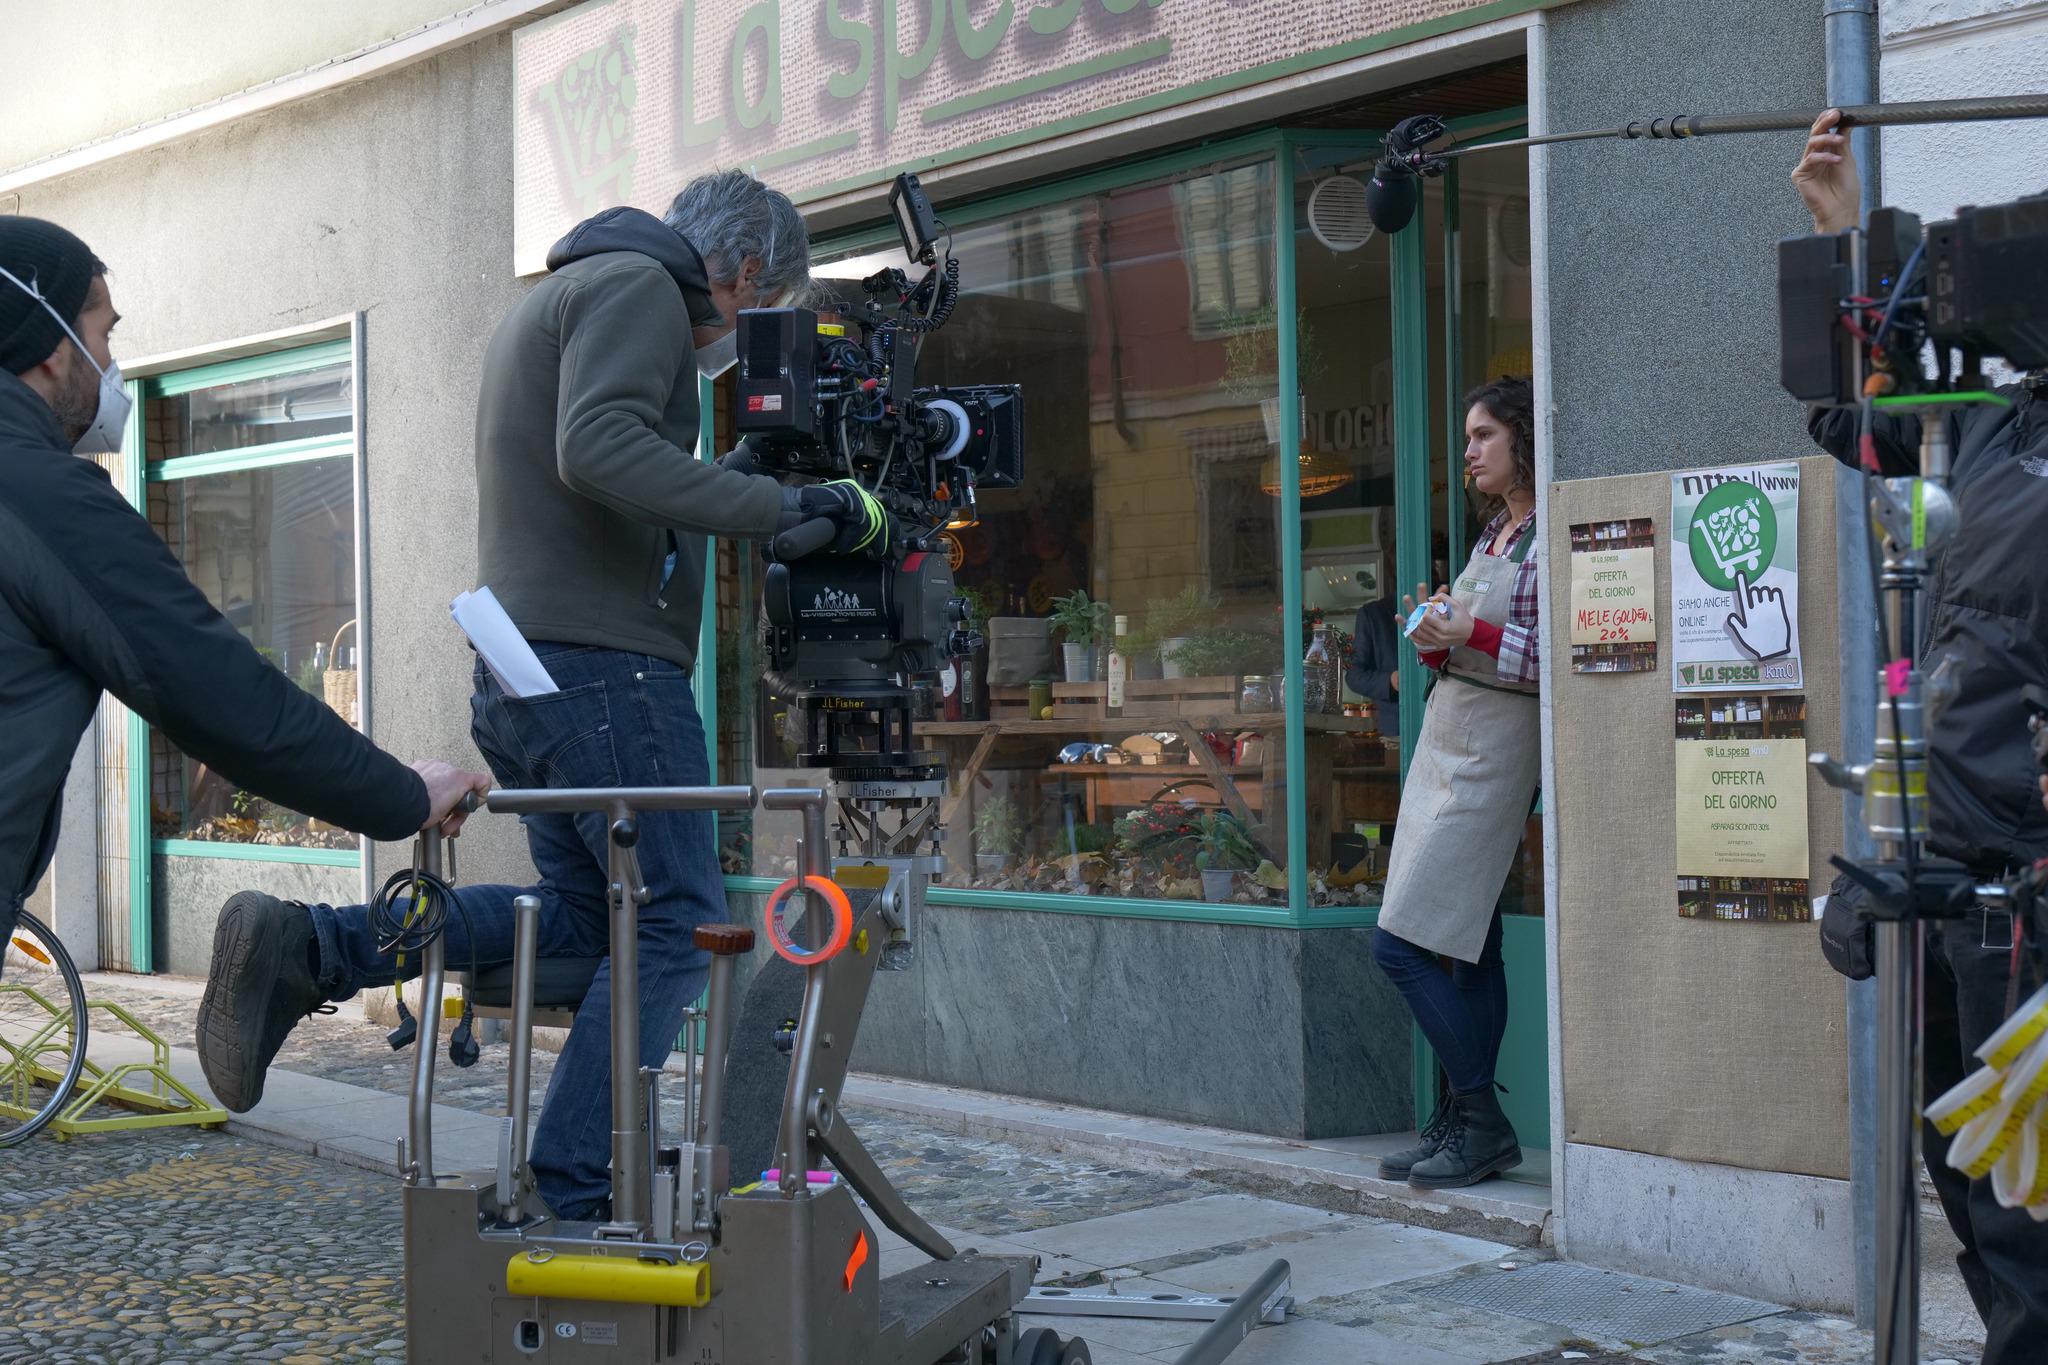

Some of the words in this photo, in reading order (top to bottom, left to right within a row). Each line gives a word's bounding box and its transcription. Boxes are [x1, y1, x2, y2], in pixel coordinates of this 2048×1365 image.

[683, 0, 783, 147] La
[1593, 570, 1628, 582] OFFERTA
[1589, 588, 1602, 599] DEL
[1605, 586, 1636, 598] GIORNO
[1703, 596, 1731, 608] ANCHE
[1577, 609, 1610, 631] MELE
[1612, 607, 1648, 626] GOLDEN
[1679, 615, 1708, 628] ONLINE!
[1600, 627, 1629, 641] 20%
[1698, 664, 1715, 681] La
[1718, 665, 1760, 684] spesa
[1764, 663, 1794, 679] km0
[1715, 745, 1725, 756] La
[1727, 747, 1750, 760] spesa
[1711, 770, 1765, 785] OFFERTA
[1704, 794, 1725, 809] DEL
[1729, 794, 1777, 809] GIORNO
